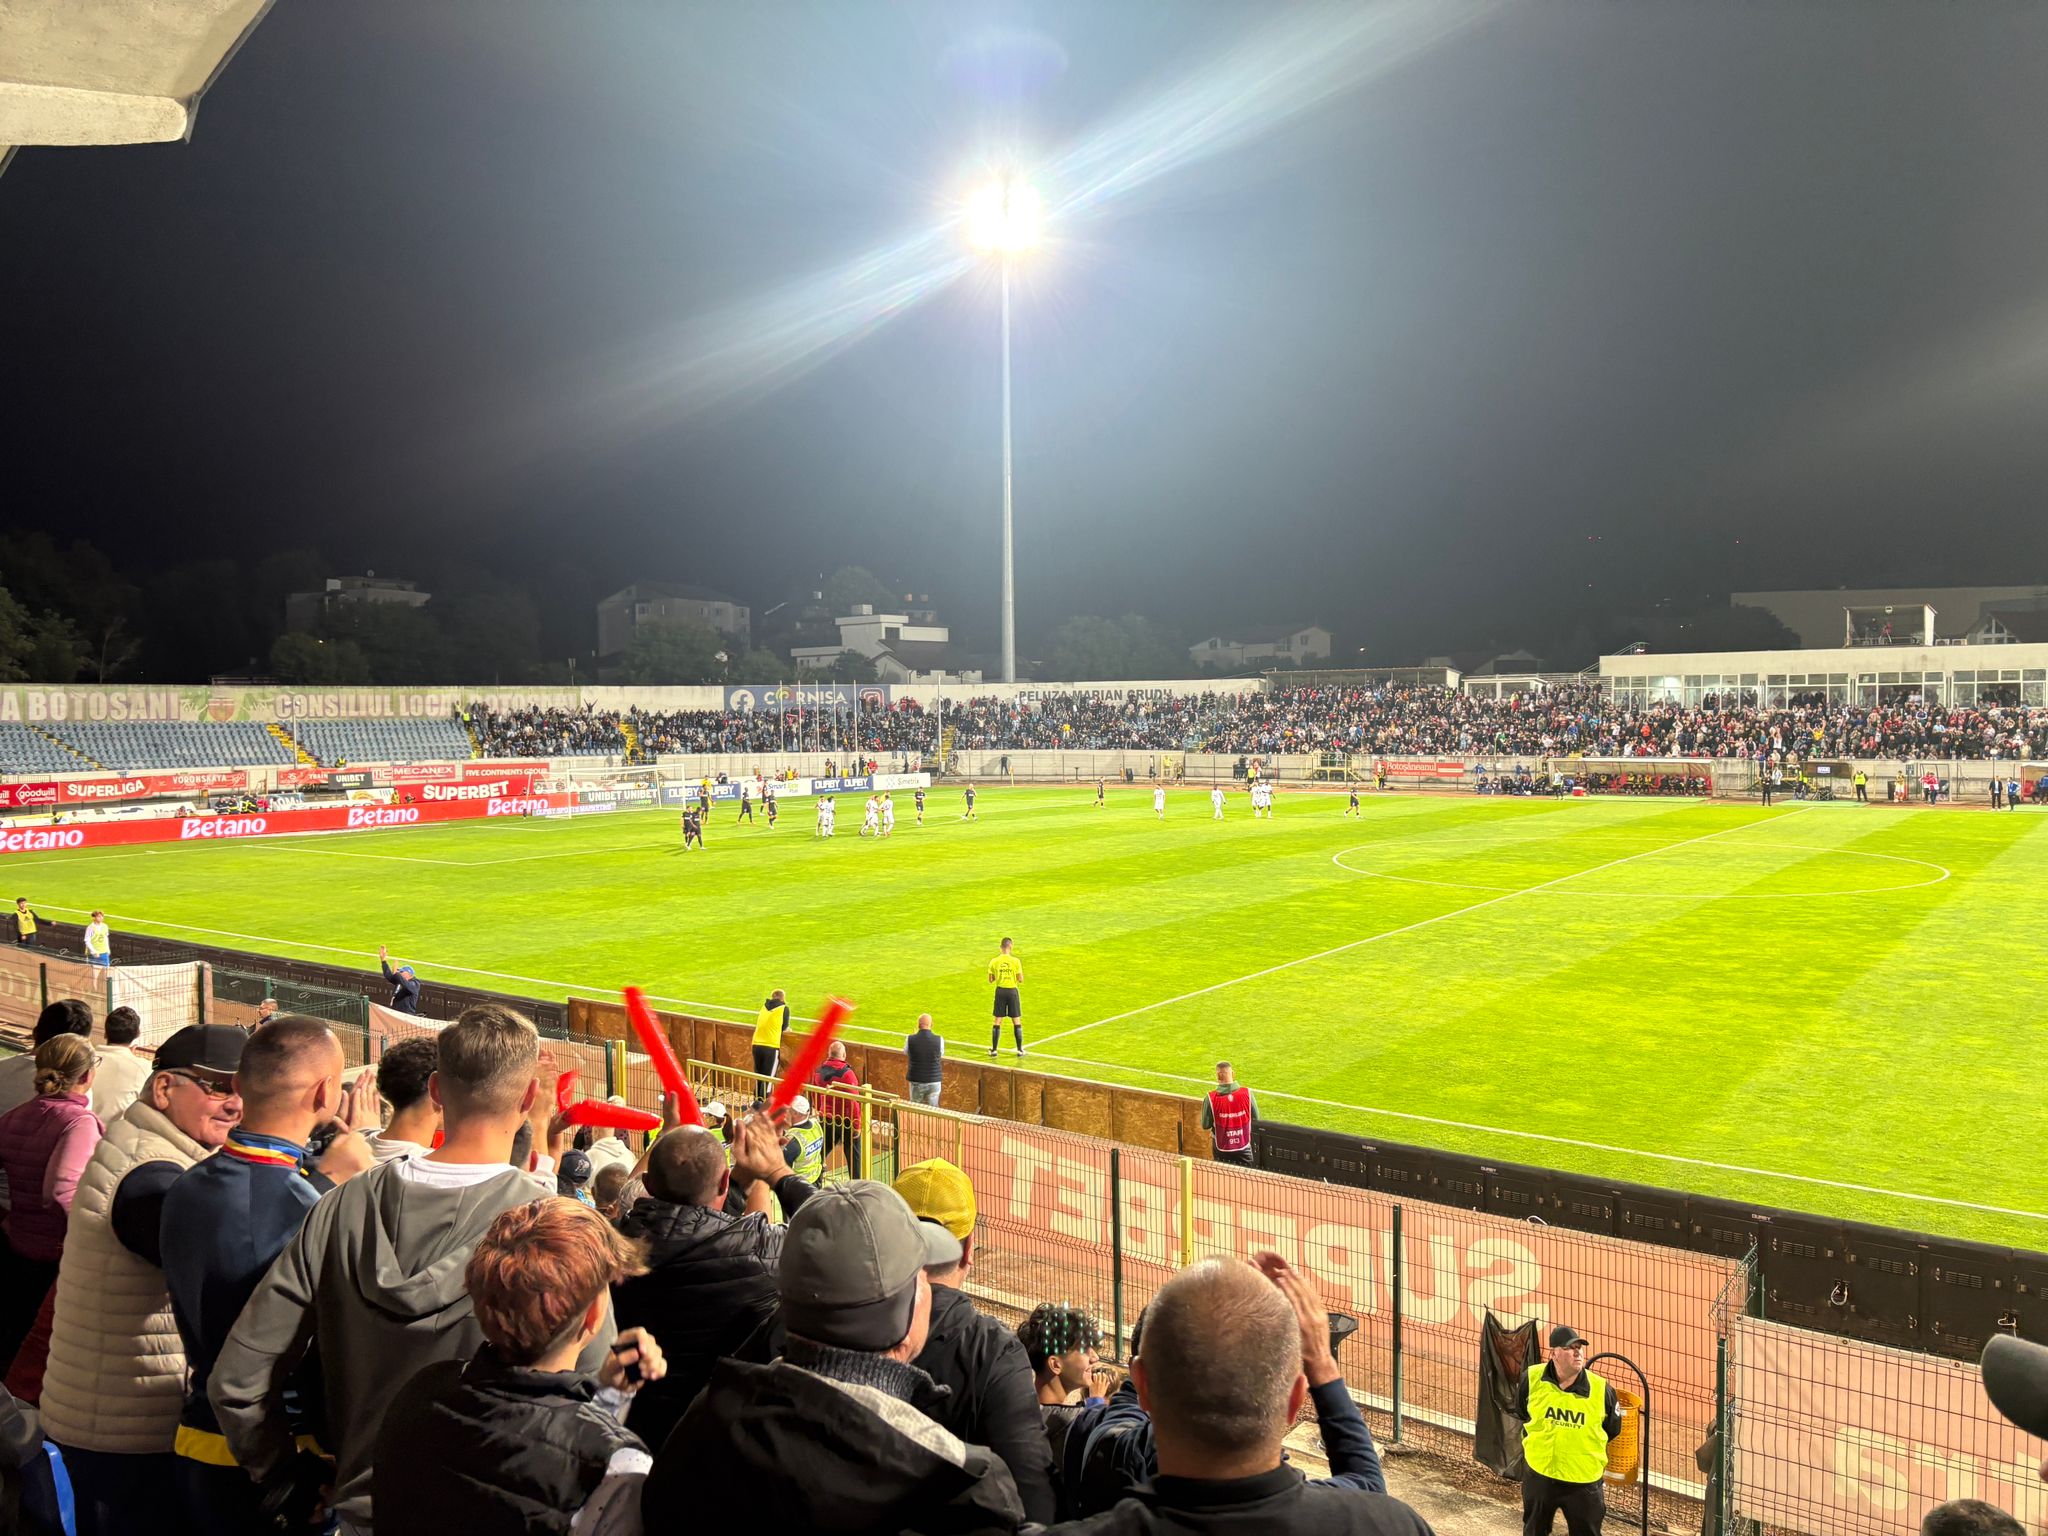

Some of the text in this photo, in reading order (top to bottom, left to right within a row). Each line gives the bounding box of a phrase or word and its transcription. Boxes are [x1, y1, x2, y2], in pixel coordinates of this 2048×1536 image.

[28, 691, 180, 721] BOTOSANI
[276, 693, 394, 718] CONSILIUL
[336, 773, 366, 783] UNIBET
[394, 766, 454, 775] MECANEX
[466, 769, 480, 777] FIVE
[481, 768, 523, 777] CONTINENTS
[68, 779, 145, 797] SUPERLIGA
[423, 781, 509, 801] SUPERBET
[487, 798, 549, 816] Betano
[347, 808, 419, 826] Betano
[181, 818, 267, 839] Betano
[1544, 1406, 1586, 1426] ANVI
[1549, 1419, 1582, 1430] ECURITY
